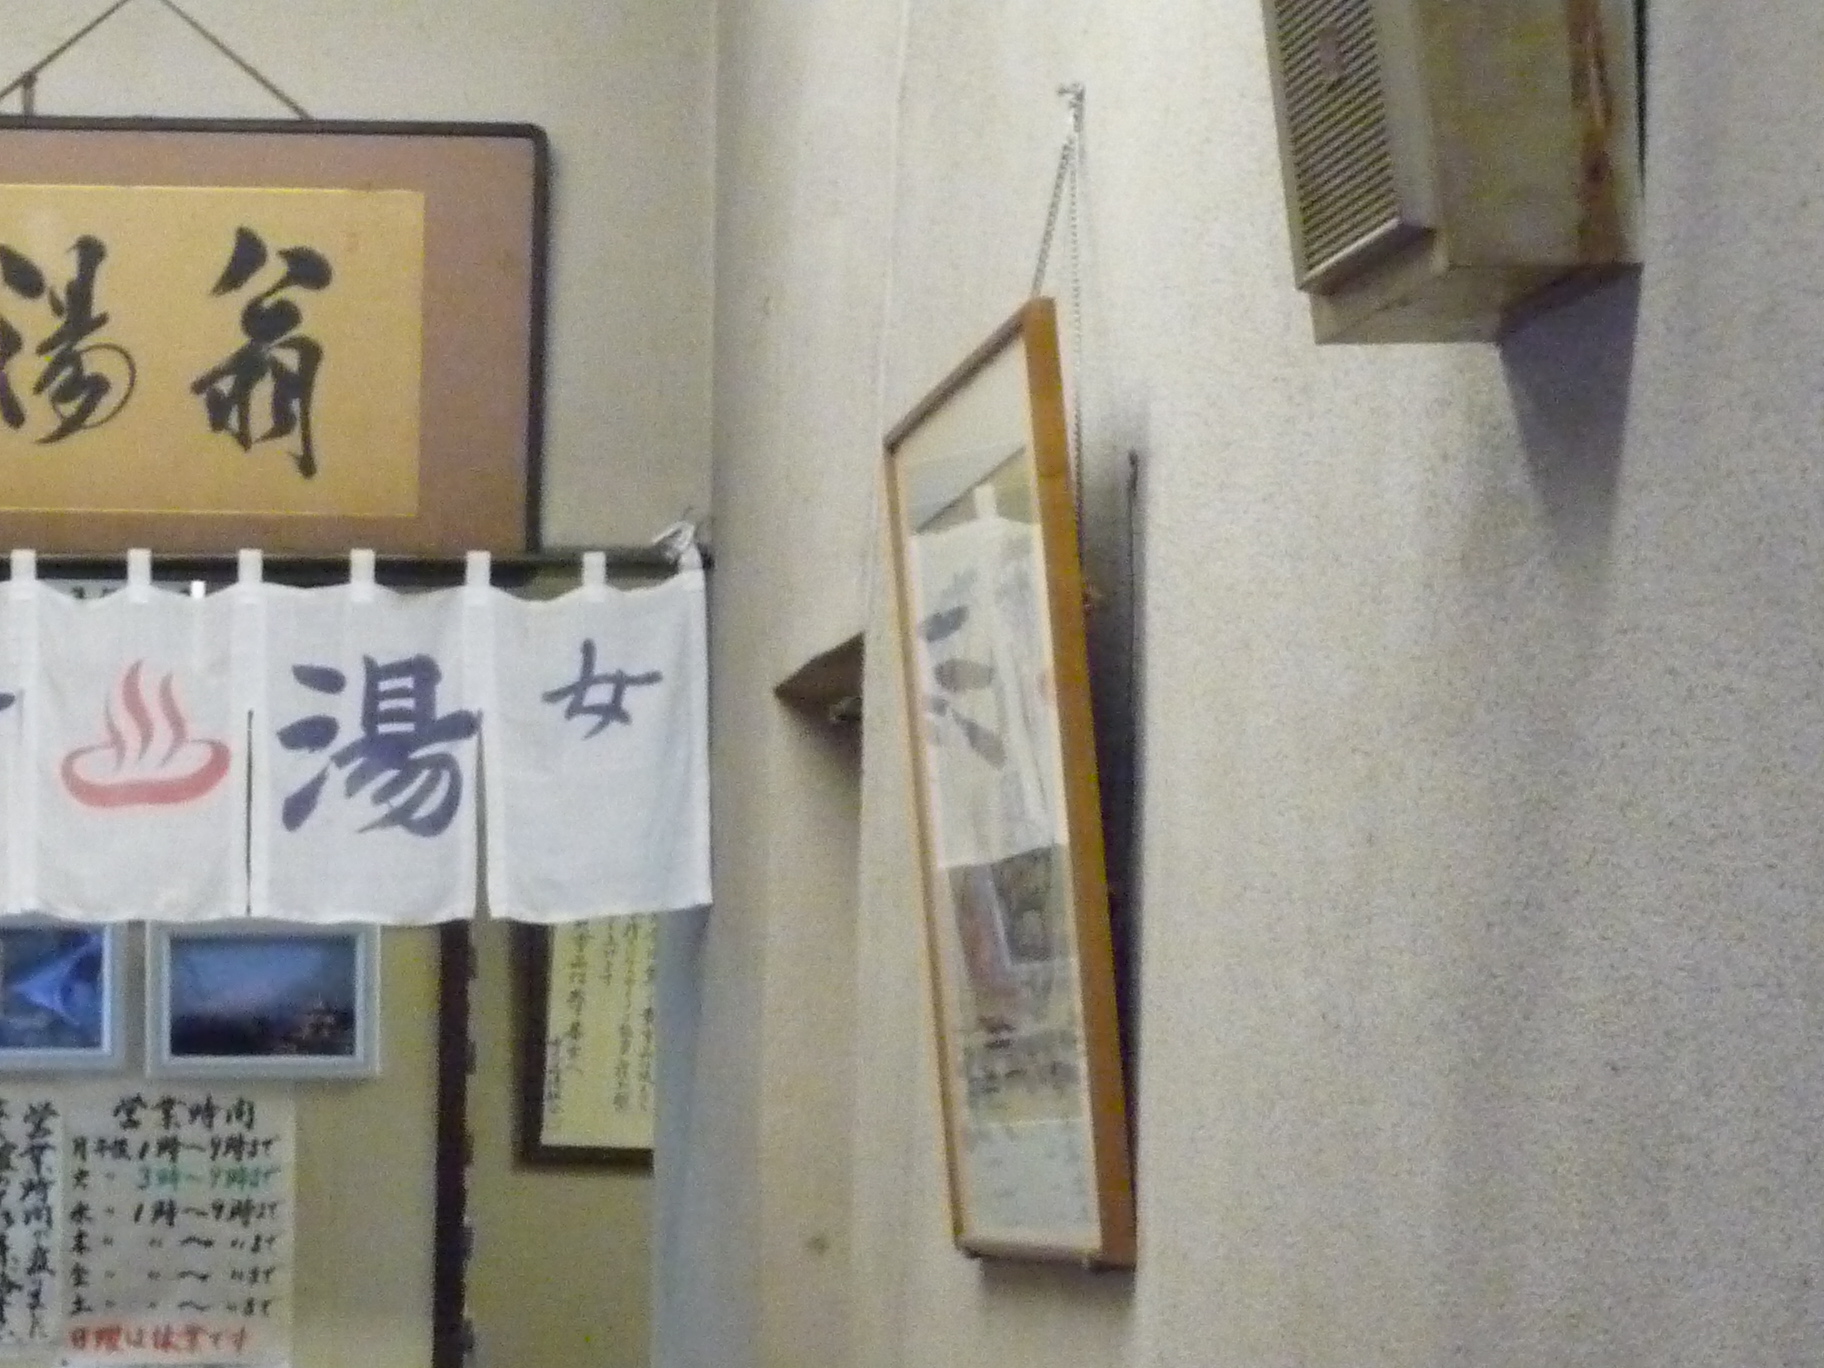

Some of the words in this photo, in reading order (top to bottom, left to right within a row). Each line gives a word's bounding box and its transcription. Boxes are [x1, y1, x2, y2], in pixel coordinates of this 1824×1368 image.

[542, 638, 662, 741] 女
[277, 653, 480, 839] 湯
[113, 1093, 255, 1130] 営業時間
